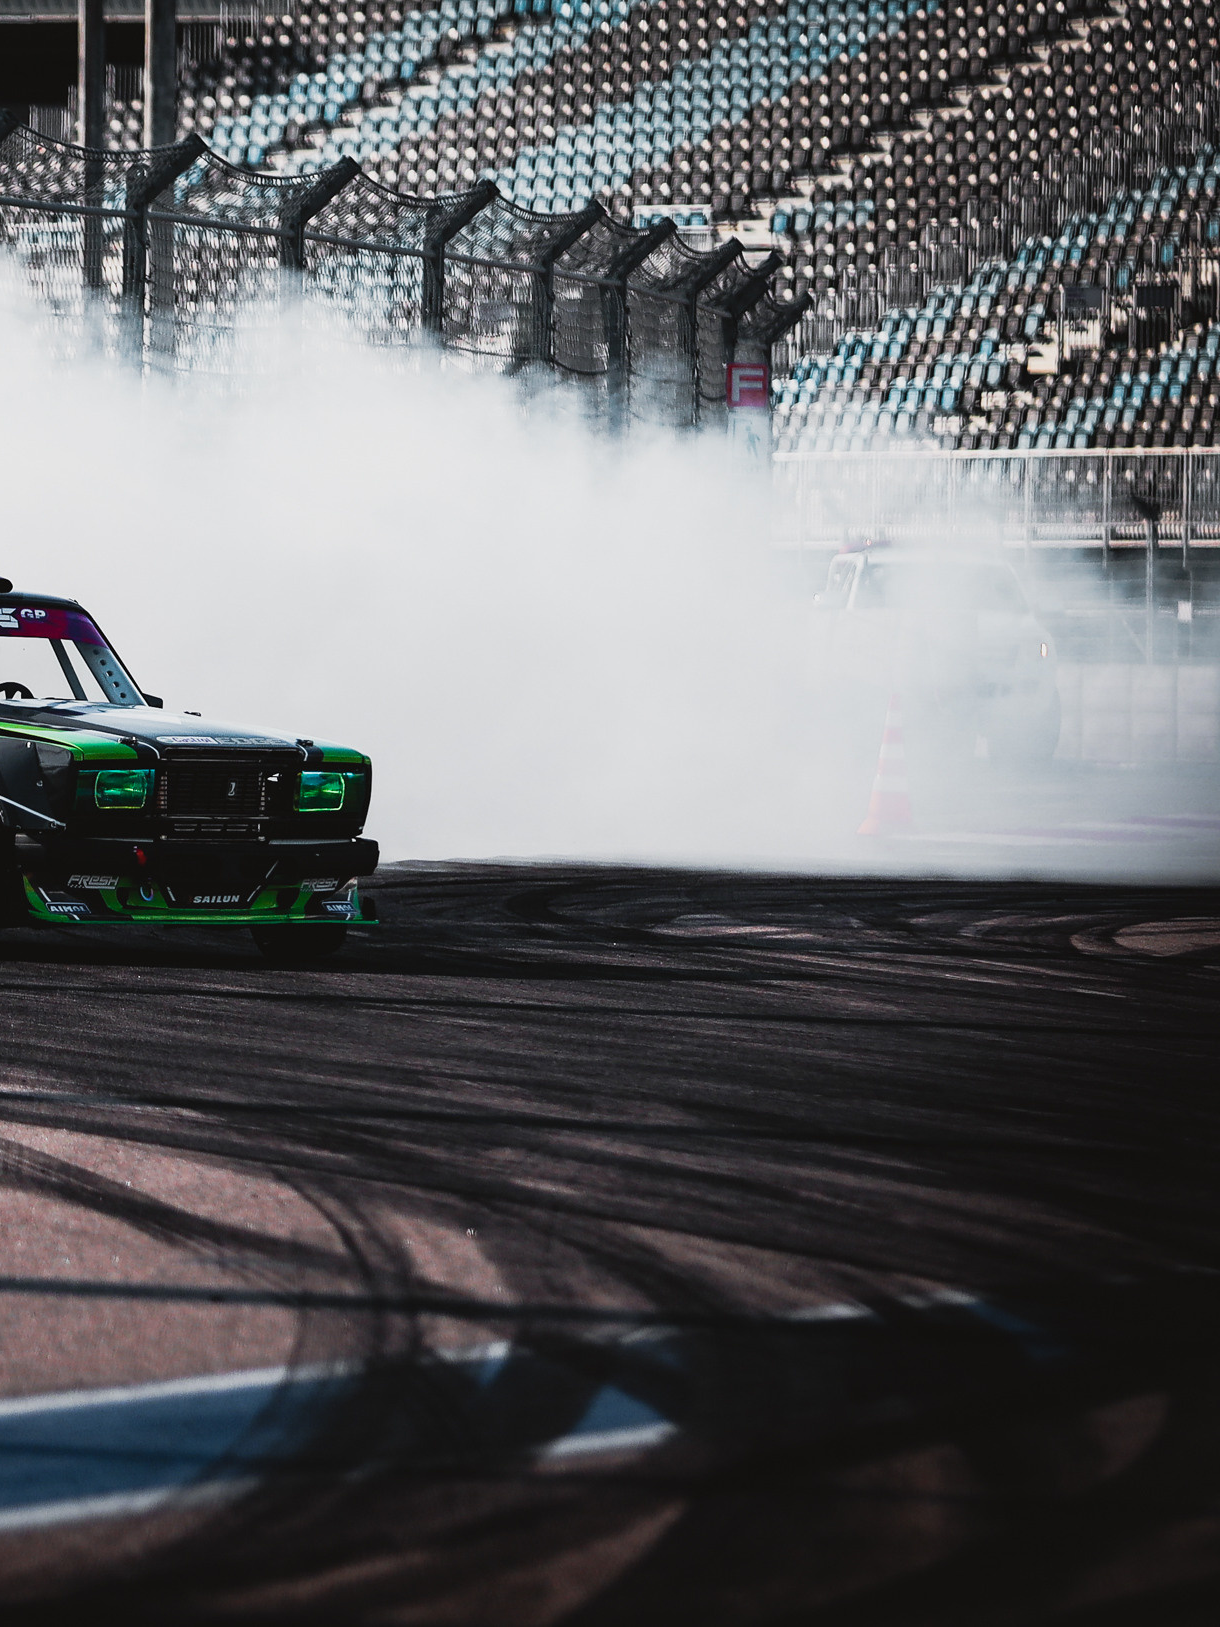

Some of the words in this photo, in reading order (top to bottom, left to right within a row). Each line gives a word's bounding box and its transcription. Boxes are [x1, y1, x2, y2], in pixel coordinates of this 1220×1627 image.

[731, 368, 764, 402] F
[20, 608, 46, 620] GP
[192, 895, 241, 904] SAILUN
